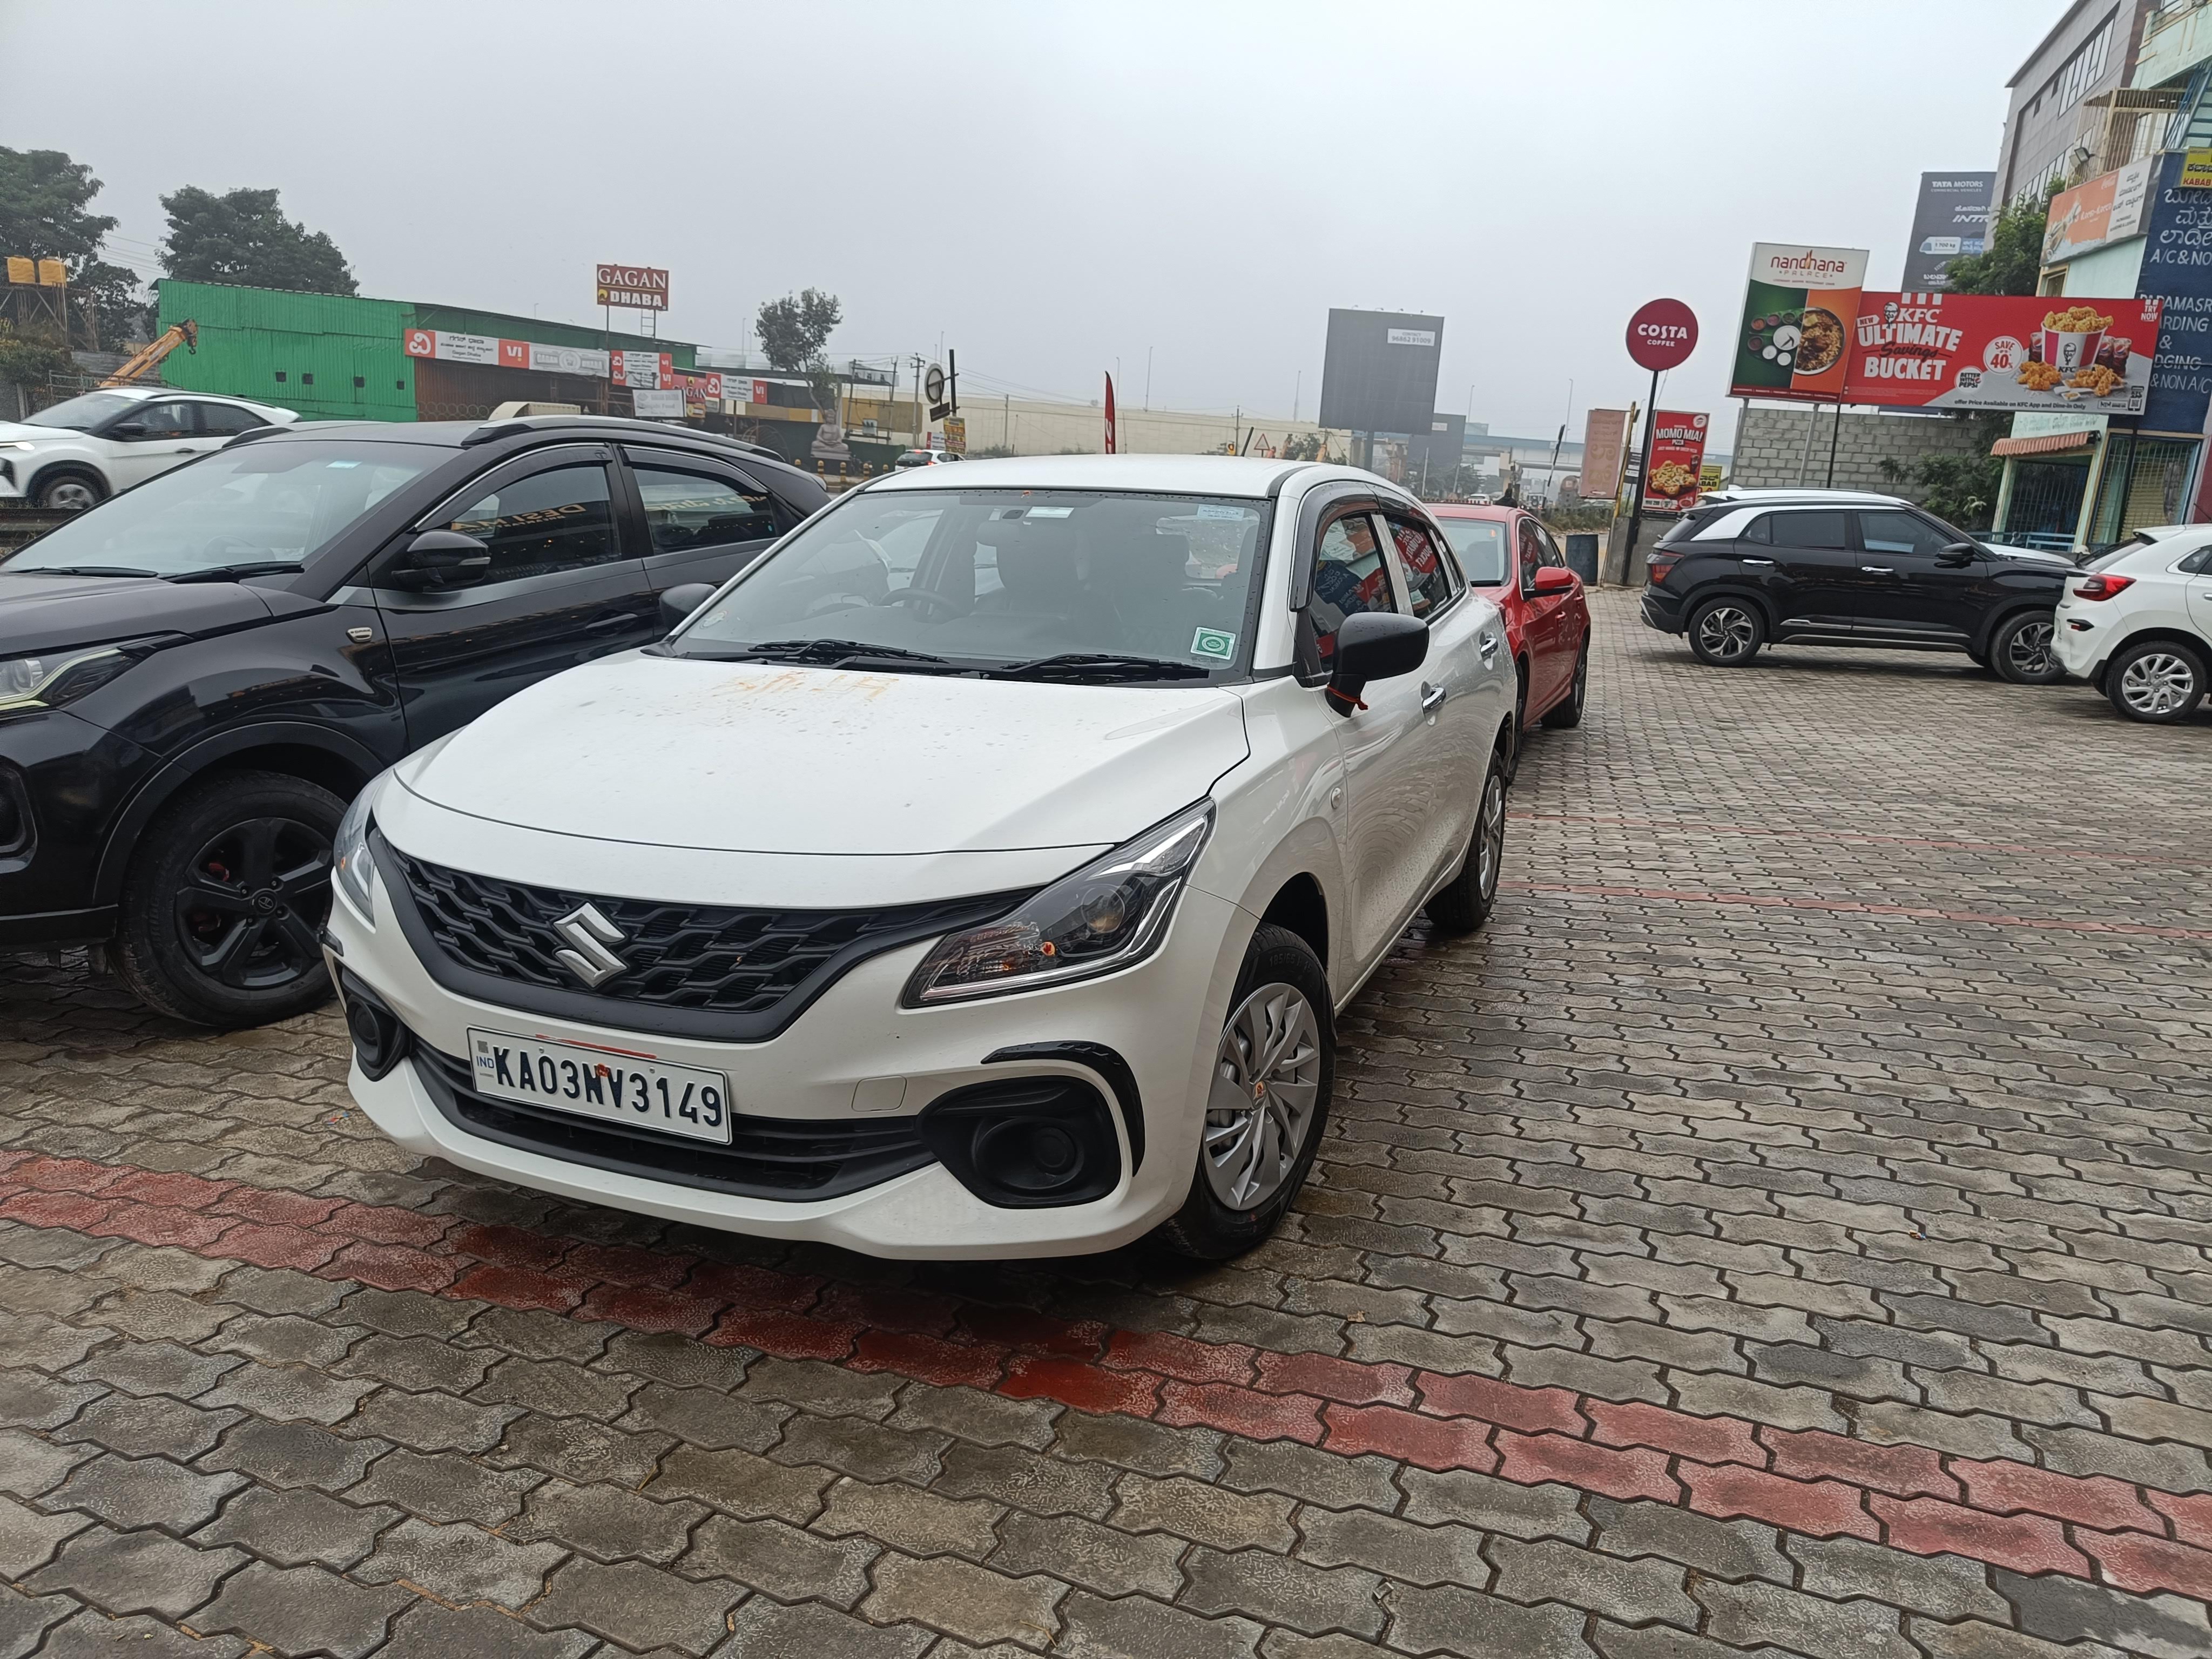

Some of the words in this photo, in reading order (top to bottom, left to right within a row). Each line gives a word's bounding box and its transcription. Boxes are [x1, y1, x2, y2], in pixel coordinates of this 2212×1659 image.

[2183, 178, 2211, 186] KABAB
[1770, 249, 1845, 273] nandhana
[598, 268, 666, 288] GAGAN
[610, 291, 663, 306] DHABA
[1896, 308, 1941, 322] KFC
[1637, 324, 1688, 339] COSTA
[2159, 315, 2209, 332] RDING
[1858, 323, 1963, 352] ULTIMATE
[1995, 341, 2015, 350] SAVE
[2159, 335, 2173, 349] &
[1879, 341, 1939, 363] Savings
[1864, 356, 1946, 380] BUCKET
[2160, 374, 2187, 390] NON
[2188, 376, 2211, 394] A/C
[1656, 428, 1682, 439] MOMO
[1683, 429, 1703, 442] MIA!
[476, 1056, 494, 1068] IND
[493, 1046, 721, 1127] KA03NV3149
